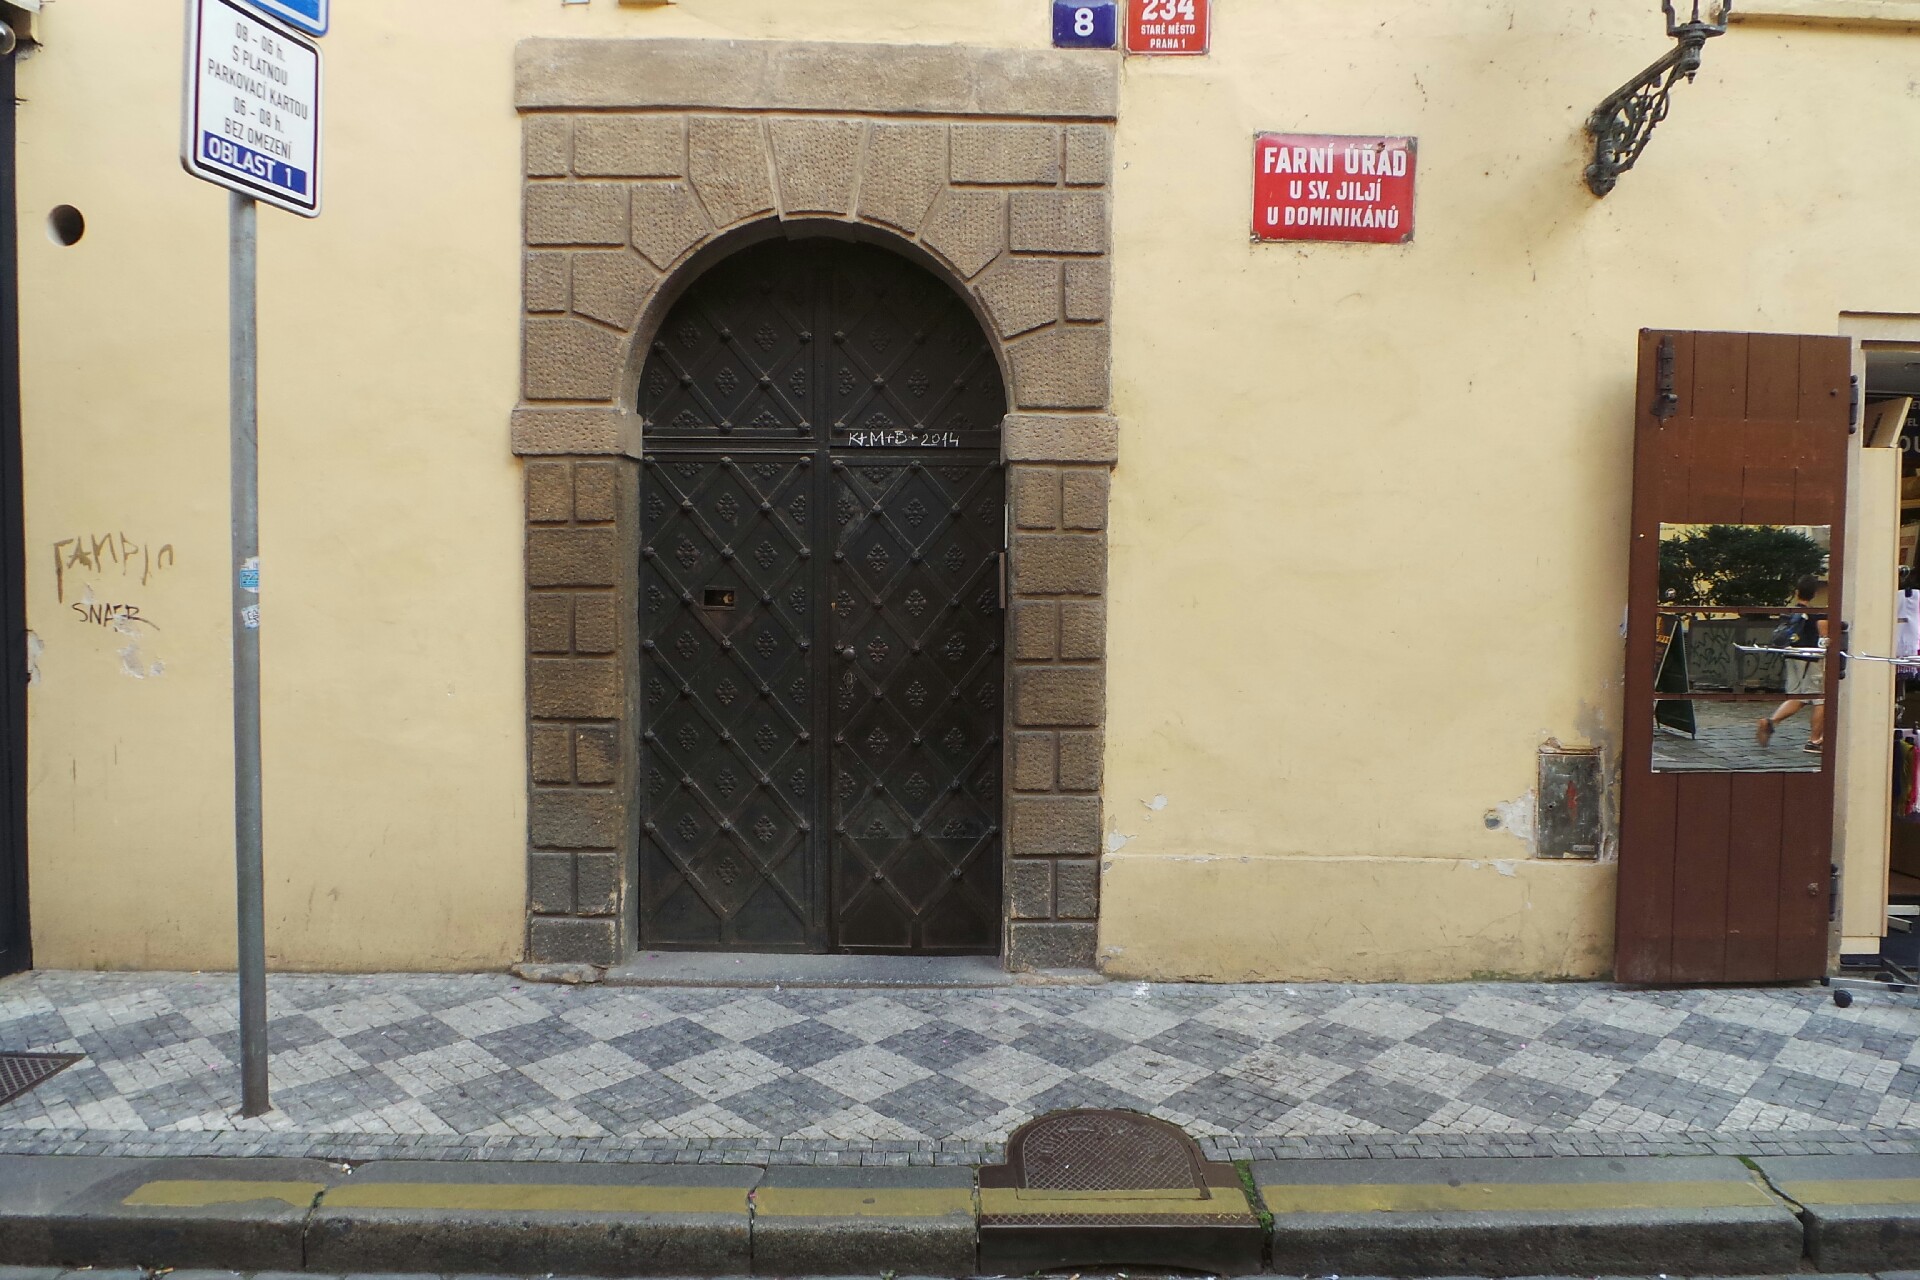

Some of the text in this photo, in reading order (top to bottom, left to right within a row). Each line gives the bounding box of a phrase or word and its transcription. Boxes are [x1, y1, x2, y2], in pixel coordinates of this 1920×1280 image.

[1074, 7, 1094, 37] 8
[1141, 0, 1195, 21] 234
[235, 22, 249, 42] 08
[261, 35, 273, 55] 06
[1140, 23, 1196, 35] STARÉ MĚSTO
[1150, 38, 1186, 49] PRAHA 1
[232, 45, 288, 86] S PLATNOU
[207, 57, 308, 120] PARKOVACÍ KARTOU
[233, 96, 246, 116] 06
[259, 107, 271, 128] 08
[224, 117, 292, 160] BEZ OMEZENÍ
[208, 137, 292, 188] OBLAST 1
[1264, 143, 1407, 177] FARNÍ ÚŘAD
[1290, 178, 1381, 202] U SV. JILJÍ
[1267, 205, 1399, 228] U DOMINIKÁNŮ
